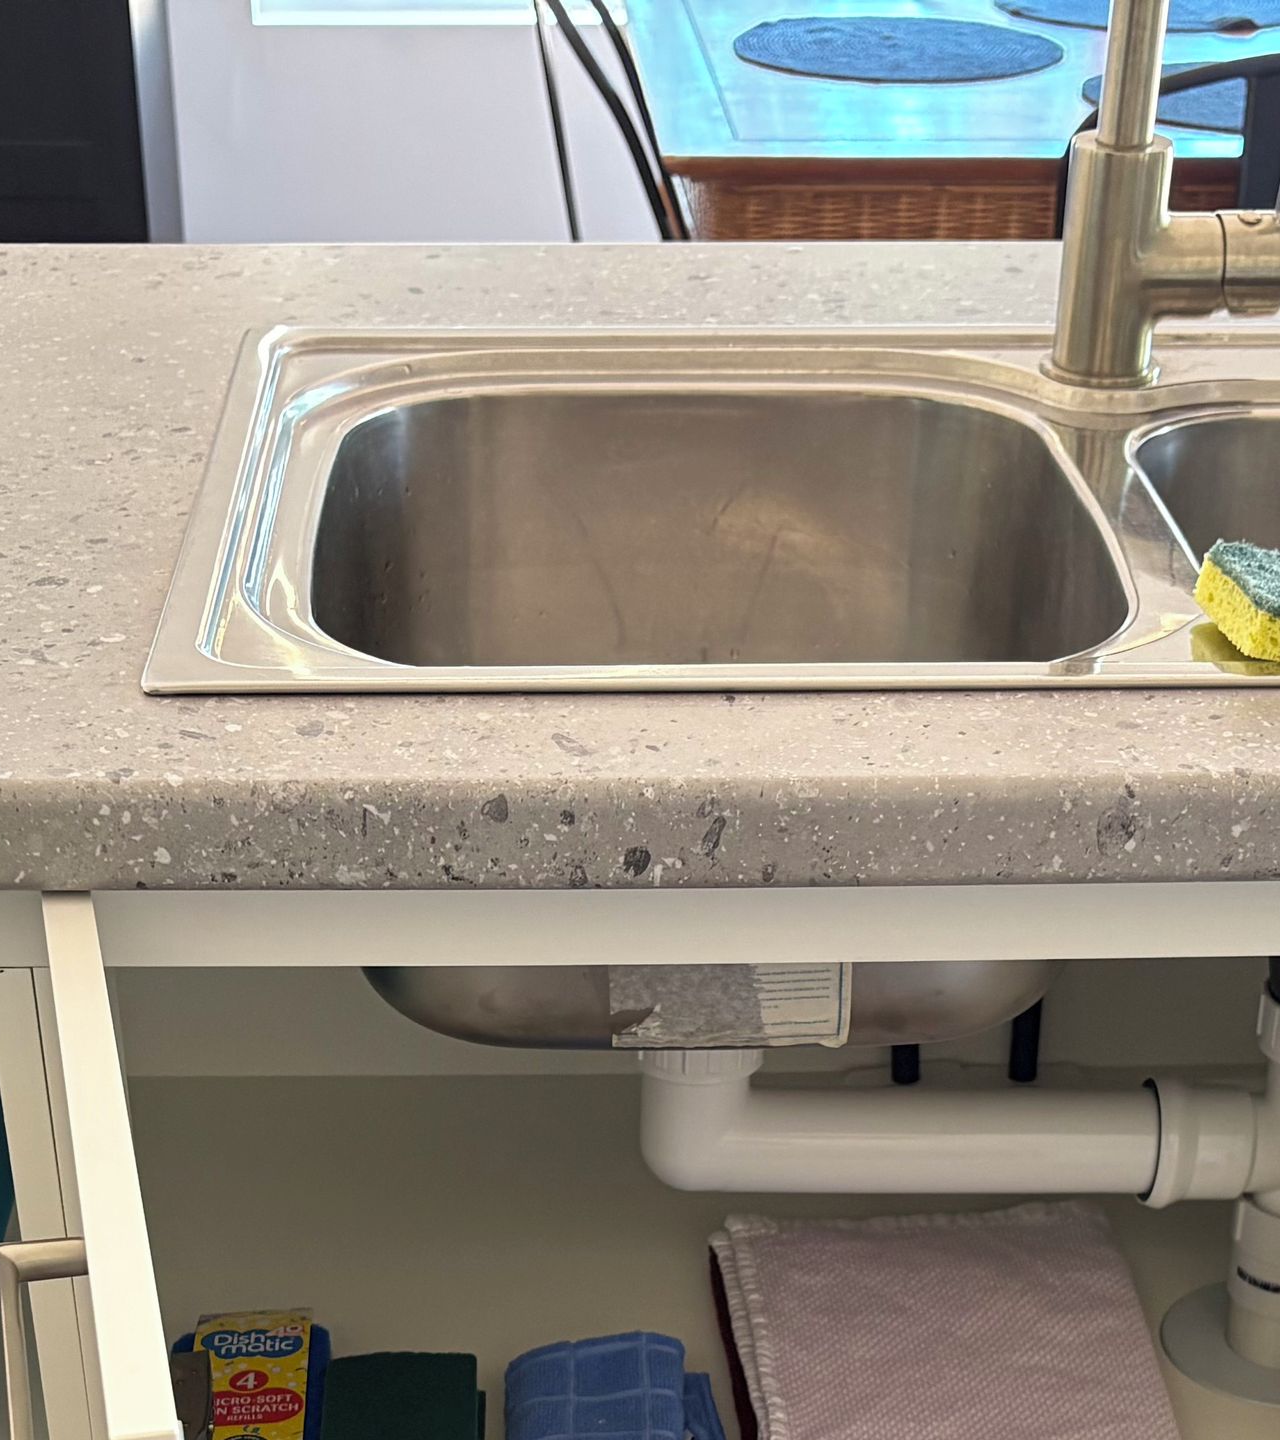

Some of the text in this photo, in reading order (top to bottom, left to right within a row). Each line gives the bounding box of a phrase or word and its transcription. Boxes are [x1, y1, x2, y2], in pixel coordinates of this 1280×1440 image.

[213, 1331, 265, 1346] Dish
[220, 1338, 294, 1355] matic
[236, 1372, 257, 1389] 4
[233, 1403, 299, 1414] SCRATCH
[227, 1413, 263, 1421] REFILLS
